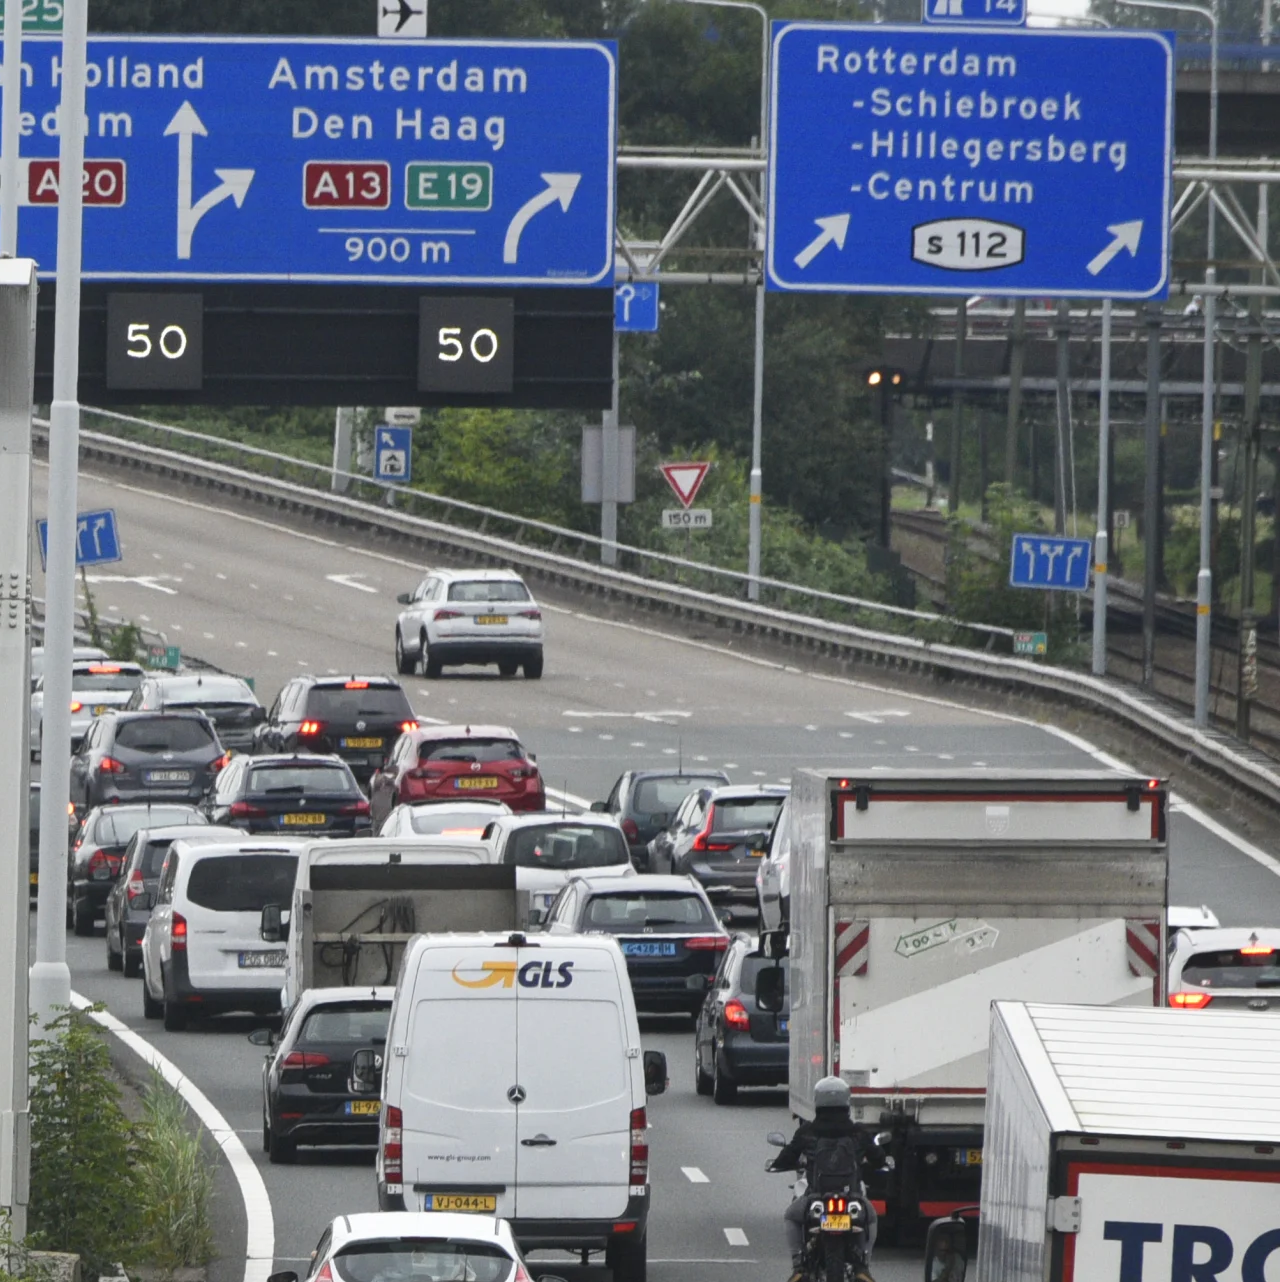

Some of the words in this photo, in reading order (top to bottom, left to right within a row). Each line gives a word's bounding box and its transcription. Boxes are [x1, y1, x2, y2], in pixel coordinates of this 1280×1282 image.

[817, 44, 1016, 77] Rotterdam
[268, 57, 528, 93] Amsterdam
[292, 107, 373, 139] Den
[395, 108, 506, 150] Haag
[313, 171, 382, 199] A13
[418, 172, 483, 201] E19
[345, 237, 410, 263] 900
[421, 241, 450, 264] m
[957, 231, 1007, 258] 112
[127, 323, 187, 359] 50
[438, 327, 498, 362] 50
[668, 513, 691, 525] 150
[694, 514, 707, 525] m
[517, 960, 574, 988] GLS
[436, 1197, 490, 1209] VJ-044-L
